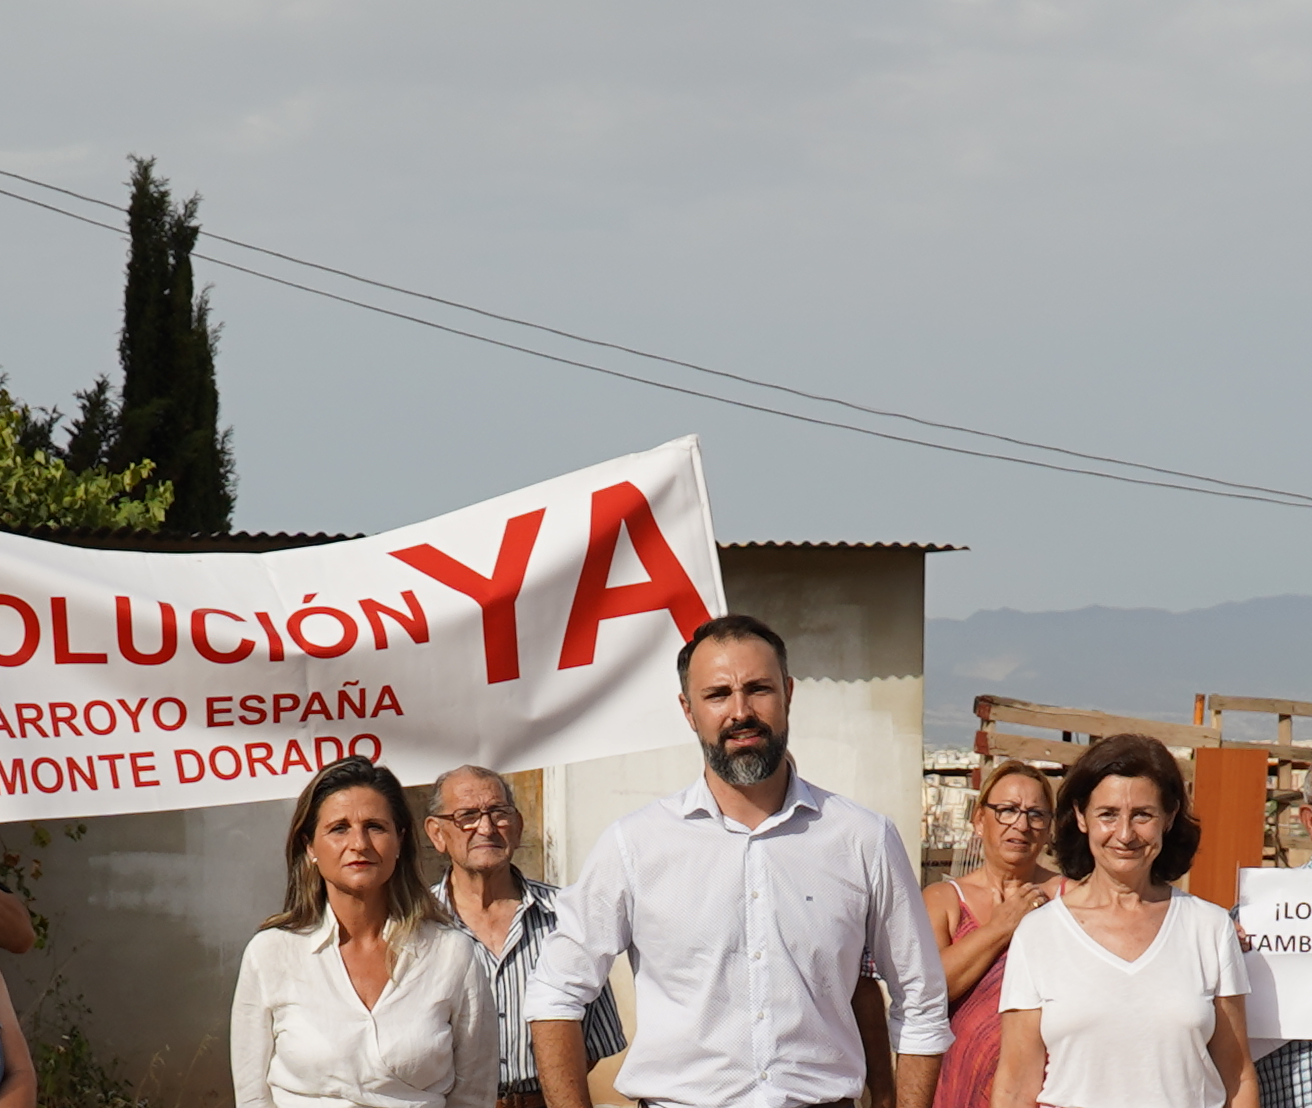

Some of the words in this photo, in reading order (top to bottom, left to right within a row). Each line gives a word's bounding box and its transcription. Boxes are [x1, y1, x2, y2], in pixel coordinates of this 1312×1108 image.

[386, 480, 713, 685] YA
[205, 680, 404, 729] ESPAÑA
[174, 733, 382, 785] DORADO
